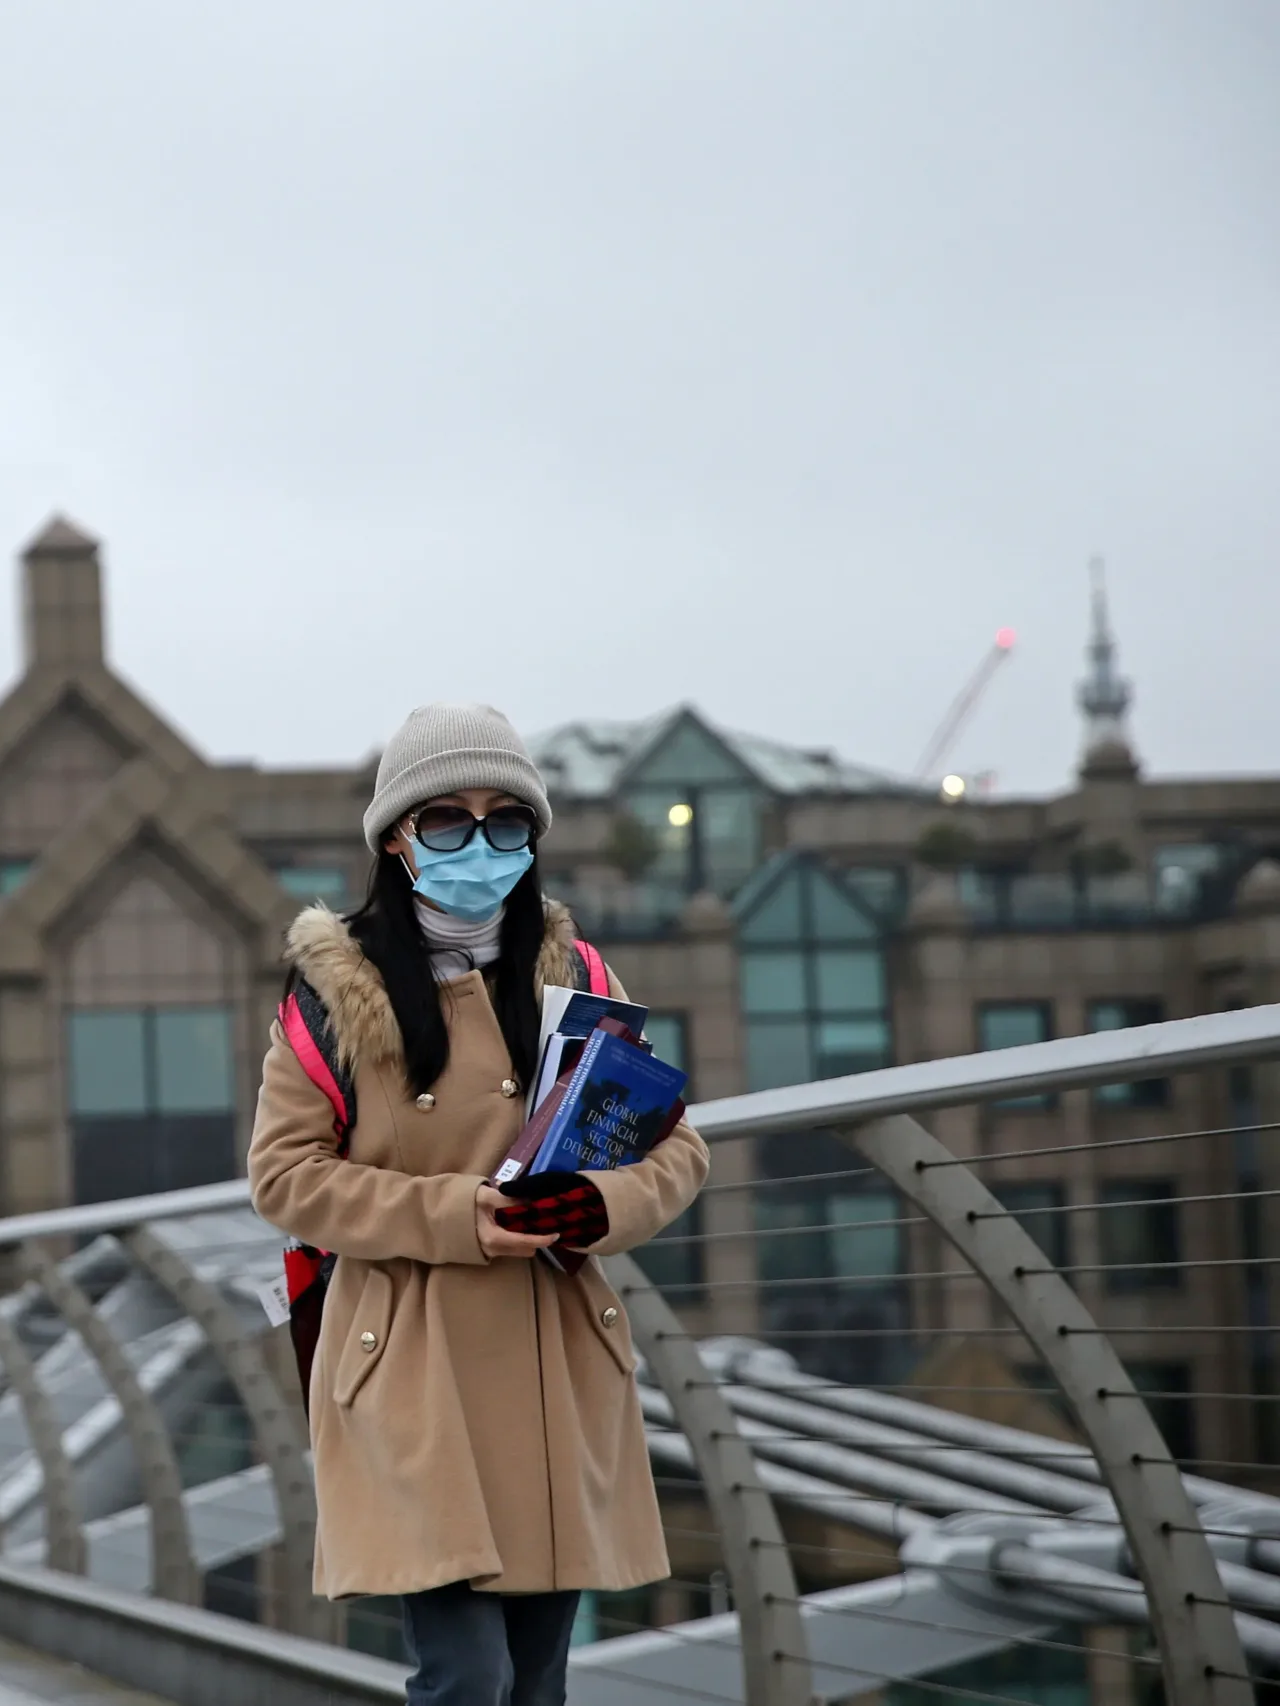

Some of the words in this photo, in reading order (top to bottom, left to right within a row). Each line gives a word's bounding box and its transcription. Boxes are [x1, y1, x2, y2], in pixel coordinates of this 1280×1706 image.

[580, 1038, 596, 1065] SECTOR
[586, 1039, 601, 1067] GLOBAL
[557, 1065, 583, 1116] DEVELOPMENT
[568, 1067, 589, 1105] FINANCIAL
[602, 1098, 639, 1125] GLOBAL
[586, 1109, 639, 1145] FINANCIAL
[586, 1129, 625, 1157] SECTOR
